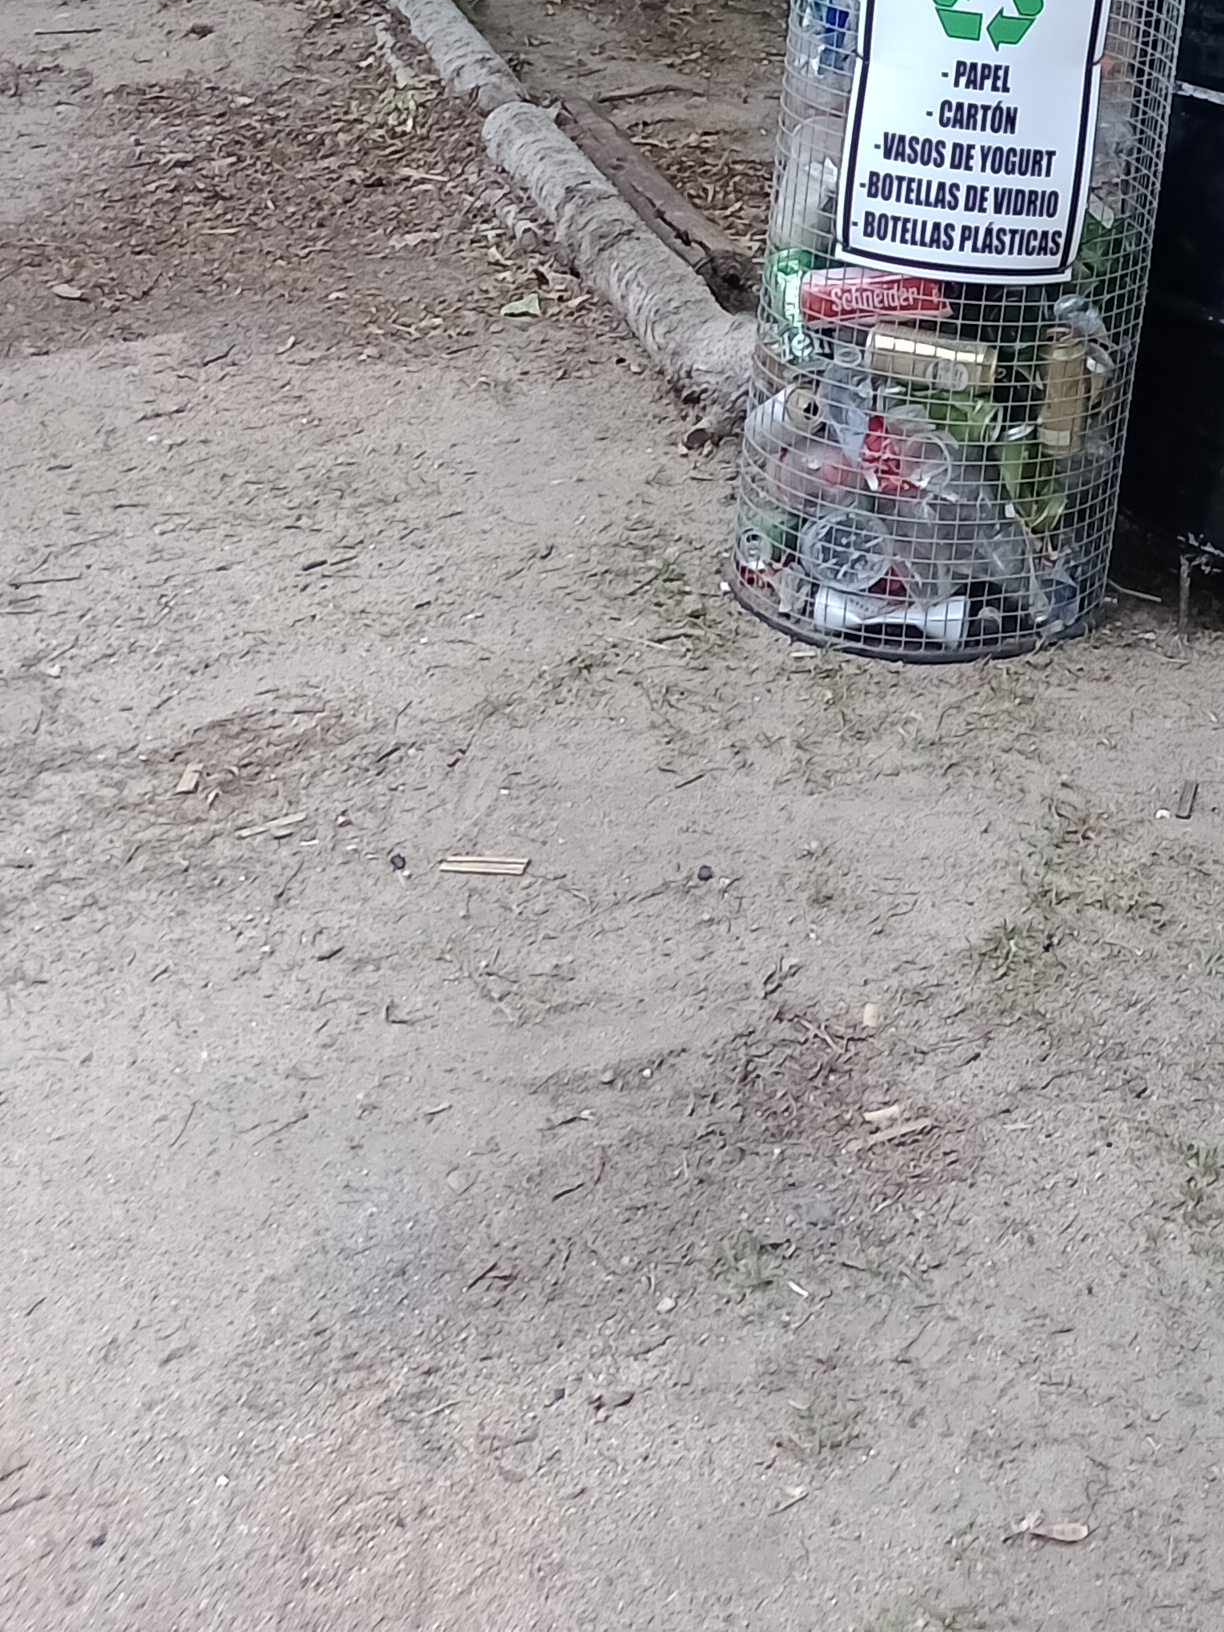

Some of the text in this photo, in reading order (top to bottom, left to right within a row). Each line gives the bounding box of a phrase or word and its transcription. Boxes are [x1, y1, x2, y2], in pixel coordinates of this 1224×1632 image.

[953, 60, 1011, 93] PAPEL
[938, 99, 1018, 134] CARTÓN
[950, 142, 976, 172] DE
[980, 145, 1057, 178] YOGURT
[964, 184, 988, 213] DE
[993, 186, 1059, 218] VIDRIO
[862, 210, 956, 252] BOTELLAS
[959, 221, 1063, 257] PLÁSTICAS
[830, 282, 918, 312] Schneider
